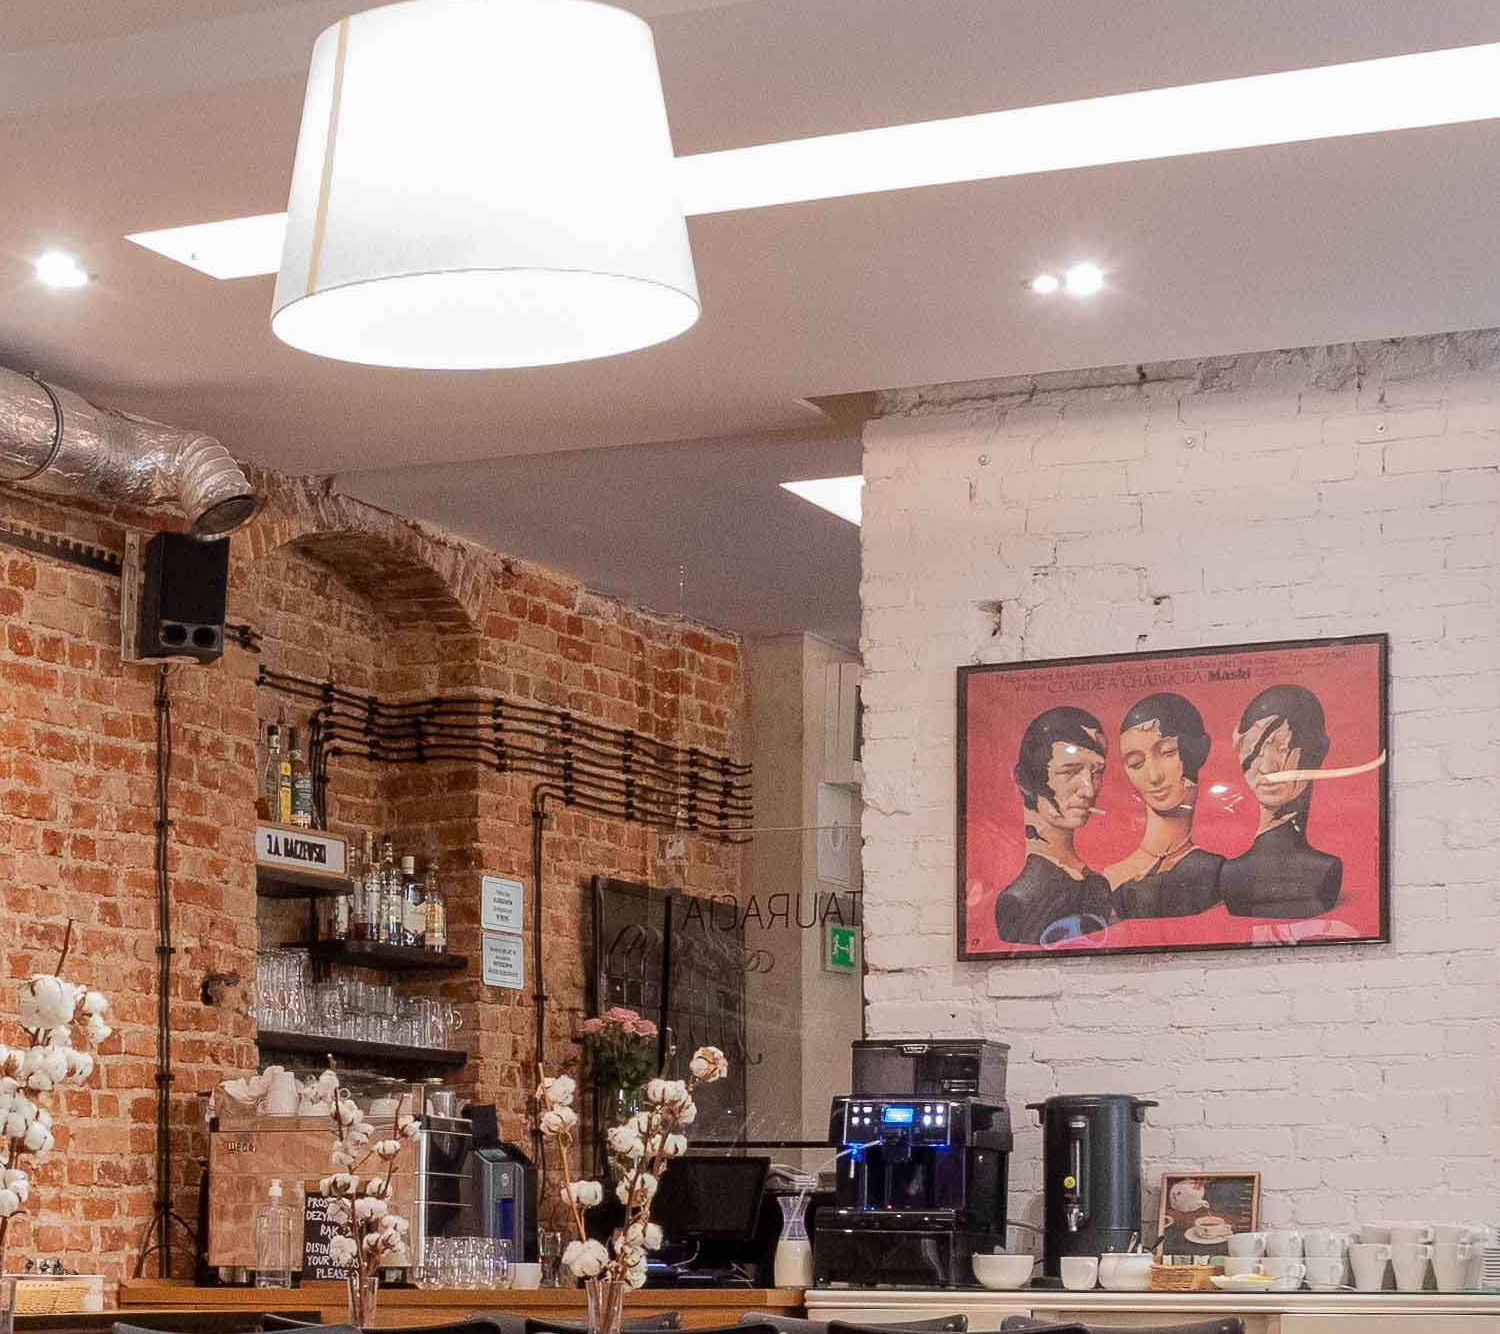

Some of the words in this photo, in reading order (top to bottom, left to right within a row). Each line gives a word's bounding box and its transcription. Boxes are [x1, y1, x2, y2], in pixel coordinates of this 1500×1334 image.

[1207, 667, 1251, 683] Maski
[307, 1255, 330, 1266] YOUR
[316, 1267, 350, 1280] PLEASE
